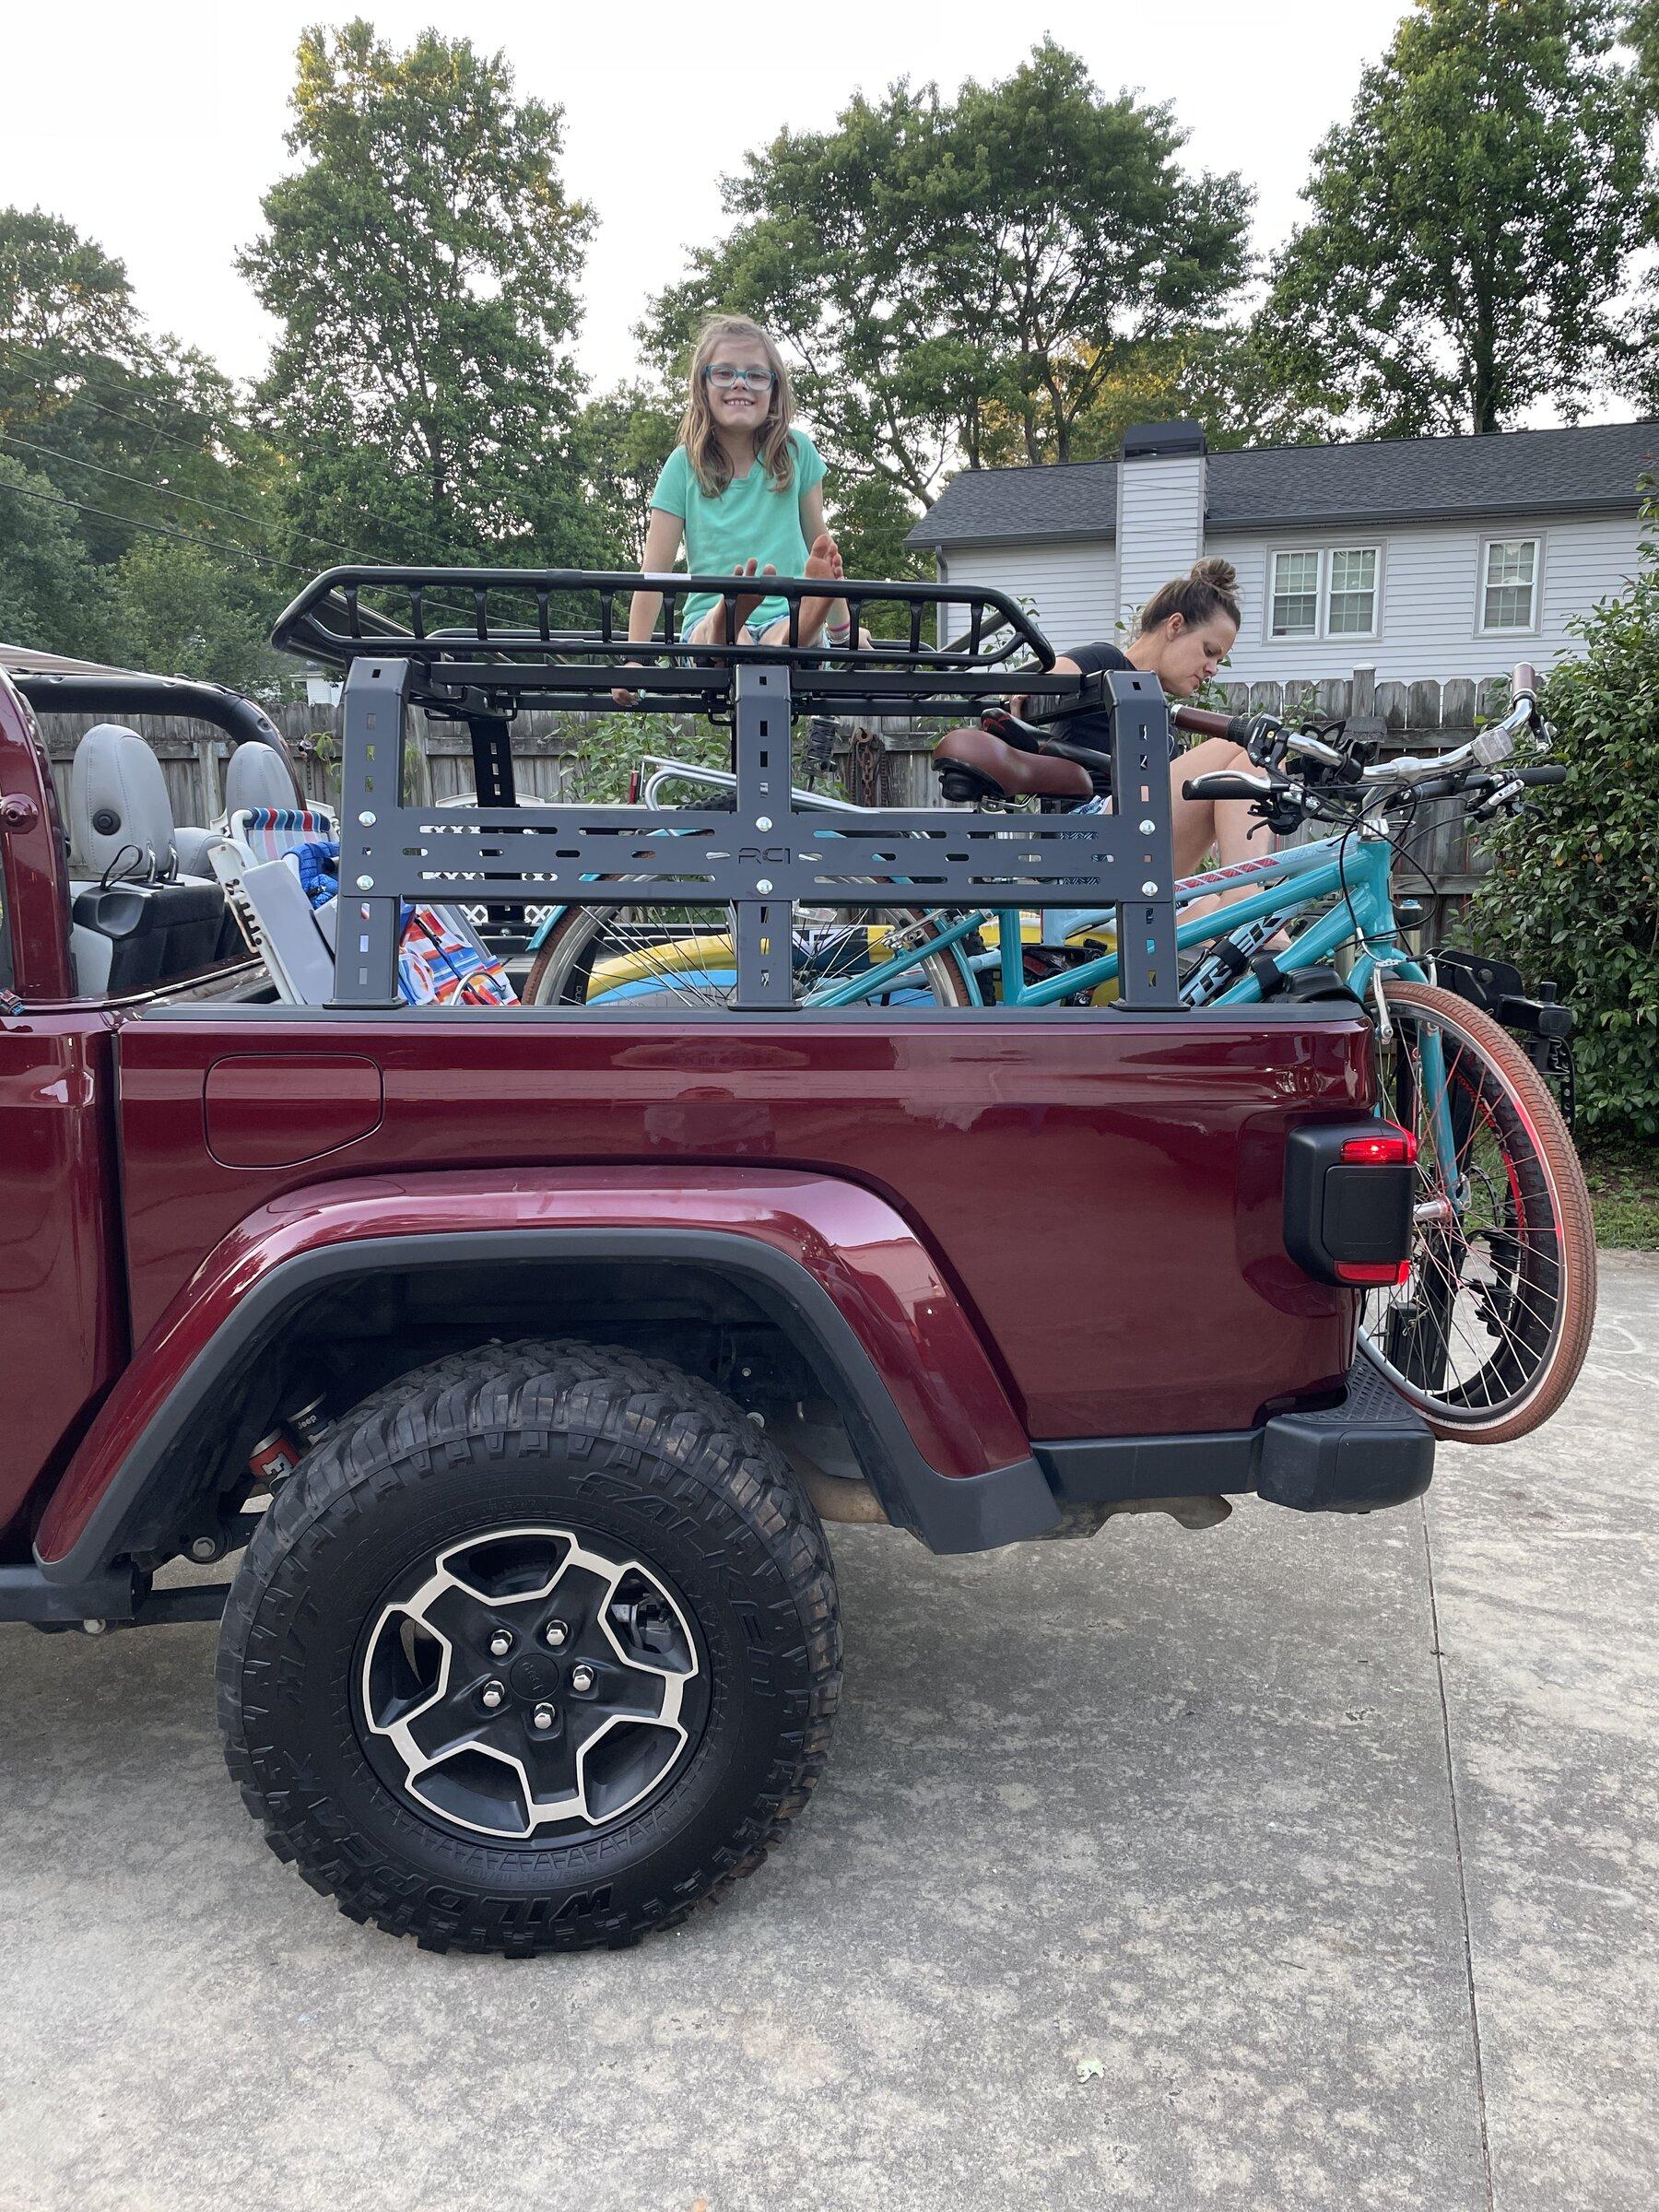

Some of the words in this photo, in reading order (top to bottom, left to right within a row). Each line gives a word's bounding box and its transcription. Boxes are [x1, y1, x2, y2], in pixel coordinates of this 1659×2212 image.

[738, 847, 791, 865] RCI
[298, 1414, 317, 1430] Jeep
[282, 1749, 615, 1933] WILDPEAK
